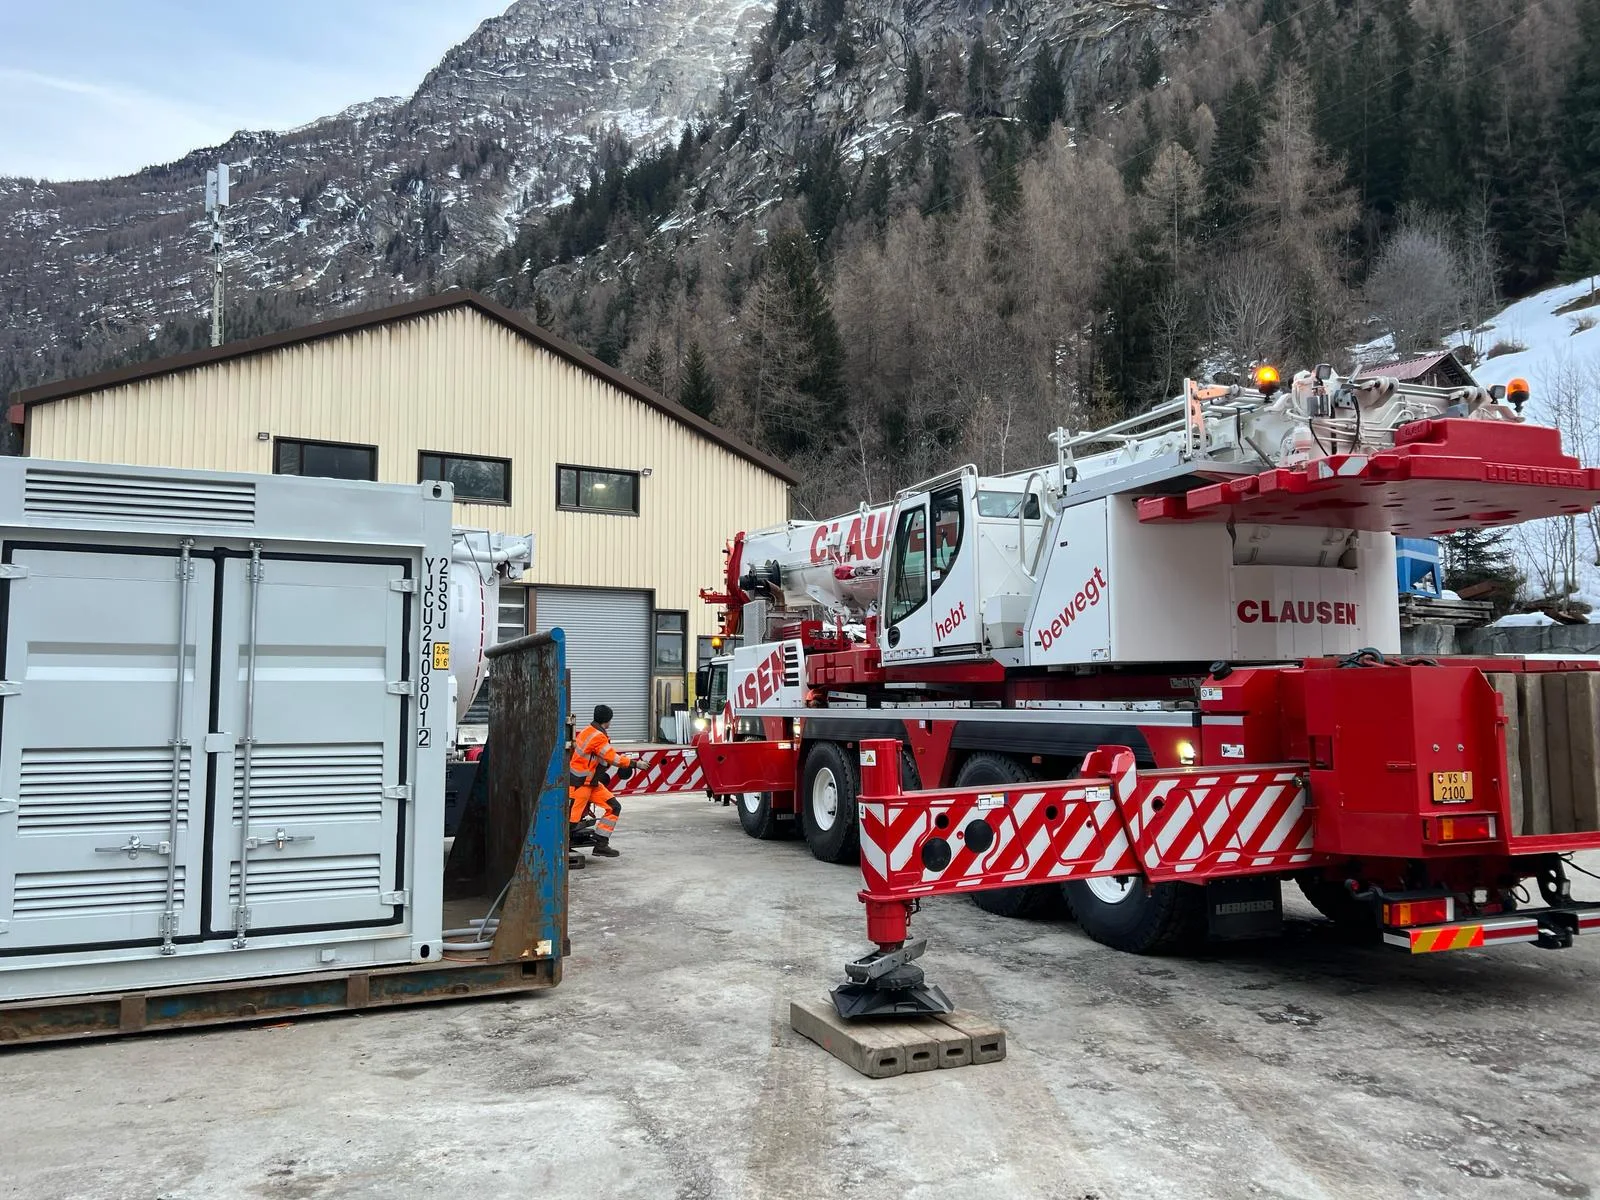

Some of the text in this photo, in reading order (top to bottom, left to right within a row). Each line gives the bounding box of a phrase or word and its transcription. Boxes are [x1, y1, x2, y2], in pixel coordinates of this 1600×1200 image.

[810, 506, 897, 564] CLAU
[438, 557, 448, 629] 25SJ
[1038, 566, 1106, 652] bewegt
[936, 600, 967, 642] hebt
[1237, 599, 1356, 625] CLAUSEN
[1442, 786, 1466, 800] 2100
[1448, 773, 1458, 784] VS
[1215, 900, 1274, 916] LIEBHERR
